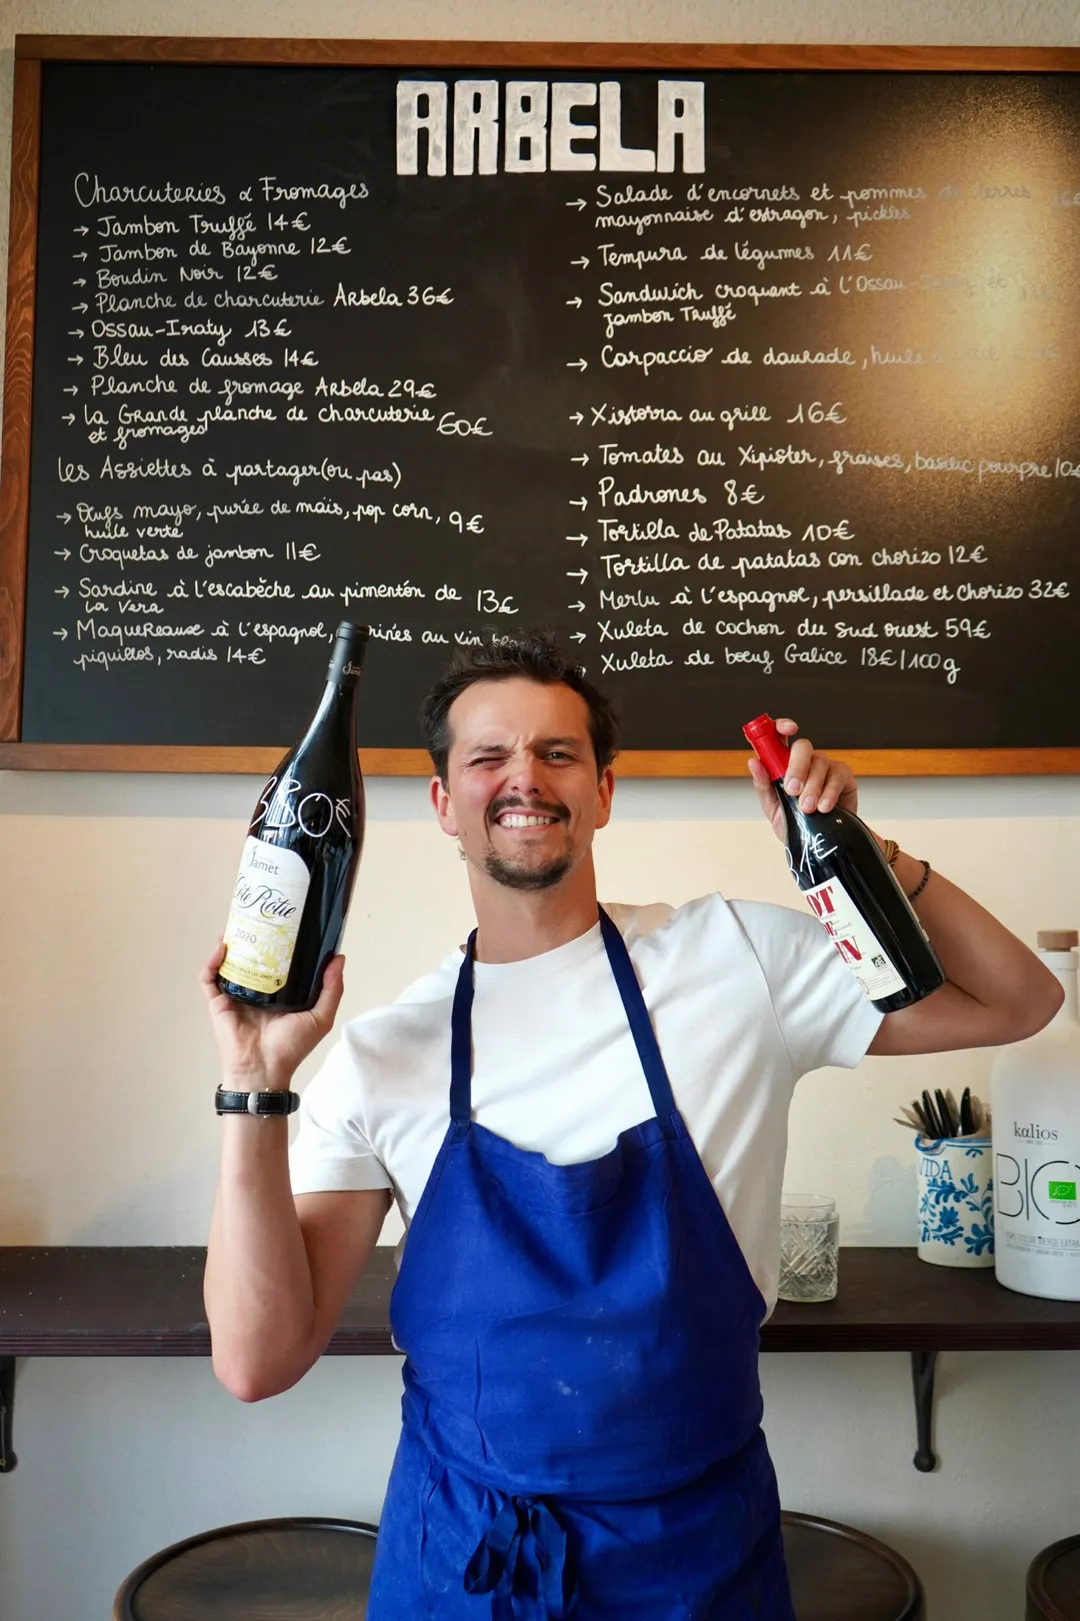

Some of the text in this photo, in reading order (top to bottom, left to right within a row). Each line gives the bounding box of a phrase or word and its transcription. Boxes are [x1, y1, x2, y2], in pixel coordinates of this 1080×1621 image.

[396, 79, 706, 177] ARBELA
[74, 172, 227, 208] Charcuteries
[258, 175, 370, 210] Fromages
[595, 183, 674, 208] Salade
[686, 183, 801, 203] d'encornets
[809, 182, 835, 202] et
[840, 185, 926, 206] pommes
[96, 211, 312, 242] Jambon Truffé 14€
[594, 205, 911, 236] mayonnaise d'estragon, pickles
[98, 236, 352, 268] Jambon de Bayonne 12€
[596, 240, 873, 271] Tempura de légumes 11€
[95, 263, 279, 290] Boudin Noir 12€
[94, 281, 455, 315] Planche de charcuterie Arbela 36€
[597, 281, 704, 307] Sandwich
[714, 282, 803, 310] croquant
[809, 276, 832, 296] à
[679, 301, 737, 329] Truffé
[90, 318, 292, 347] Ossau-Iraty 13€
[92, 343, 320, 370] Bleu des Causses 14€
[600, 344, 714, 377] Carpaccio
[720, 347, 753, 365] de
[762, 346, 855, 366] daurade
[90, 373, 437, 407] Planche de fromage Arbela 29€
[118, 403, 189, 425] Grande
[198, 404, 278, 436] planche
[285, 405, 309, 422] de
[317, 402, 436, 423] charcuterie
[435, 411, 494, 437] 60€
[688, 408, 716, 423] au
[719, 404, 772, 432] grill
[786, 401, 847, 424] 16€
[87, 425, 209, 451] et fromages
[99, 454, 192, 480] Assiettes
[201, 457, 218, 477] à
[598, 443, 685, 466] Tomates
[696, 449, 726, 467] au
[597, 475, 766, 508] Padrones 8€
[132, 503, 202, 527] mayo,
[206, 498, 265, 524] purée
[270, 499, 292, 515] de
[351, 503, 387, 524] pop
[392, 502, 441, 525] corn,
[448, 510, 485, 534] 9€
[596, 517, 681, 542] Tortilla
[688, 522, 714, 543] de
[801, 519, 856, 543] 10€
[83, 524, 184, 540] huile verte
[79, 540, 322, 571] Croquetas de jambon 11€
[599, 544, 989, 580] Tortilla de patatas con chorizo 12€
[78, 576, 158, 599] Sardine
[166, 578, 190, 599] à
[301, 583, 335, 600] au
[339, 579, 426, 608] pimentón
[434, 583, 463, 602] de
[477, 589, 520, 615] 13€
[118, 598, 165, 615] Vera
[599, 589, 661, 611] Merlu
[669, 585, 693, 606] à
[821, 582, 930, 610] persillade
[932, 584, 955, 602] et
[1027, 578, 1071, 600] 32€
[210, 619, 230, 637] à
[421, 630, 450, 644] au
[596, 617, 669, 643] Xuleta
[682, 617, 706, 636] de
[715, 618, 786, 636] cochon
[797, 617, 828, 637] du
[883, 620, 939, 639] ouest
[945, 617, 992, 640] 59€
[166, 645, 218, 661] radis
[226, 645, 267, 665] 14€
[600, 648, 674, 675] Xuleta
[683, 649, 715, 666] de
[784, 642, 848, 665] Galice
[248, 844, 280, 876] Jamet
[234, 927, 257, 944] 2020
[1014, 1121, 1058, 1141] kalios
